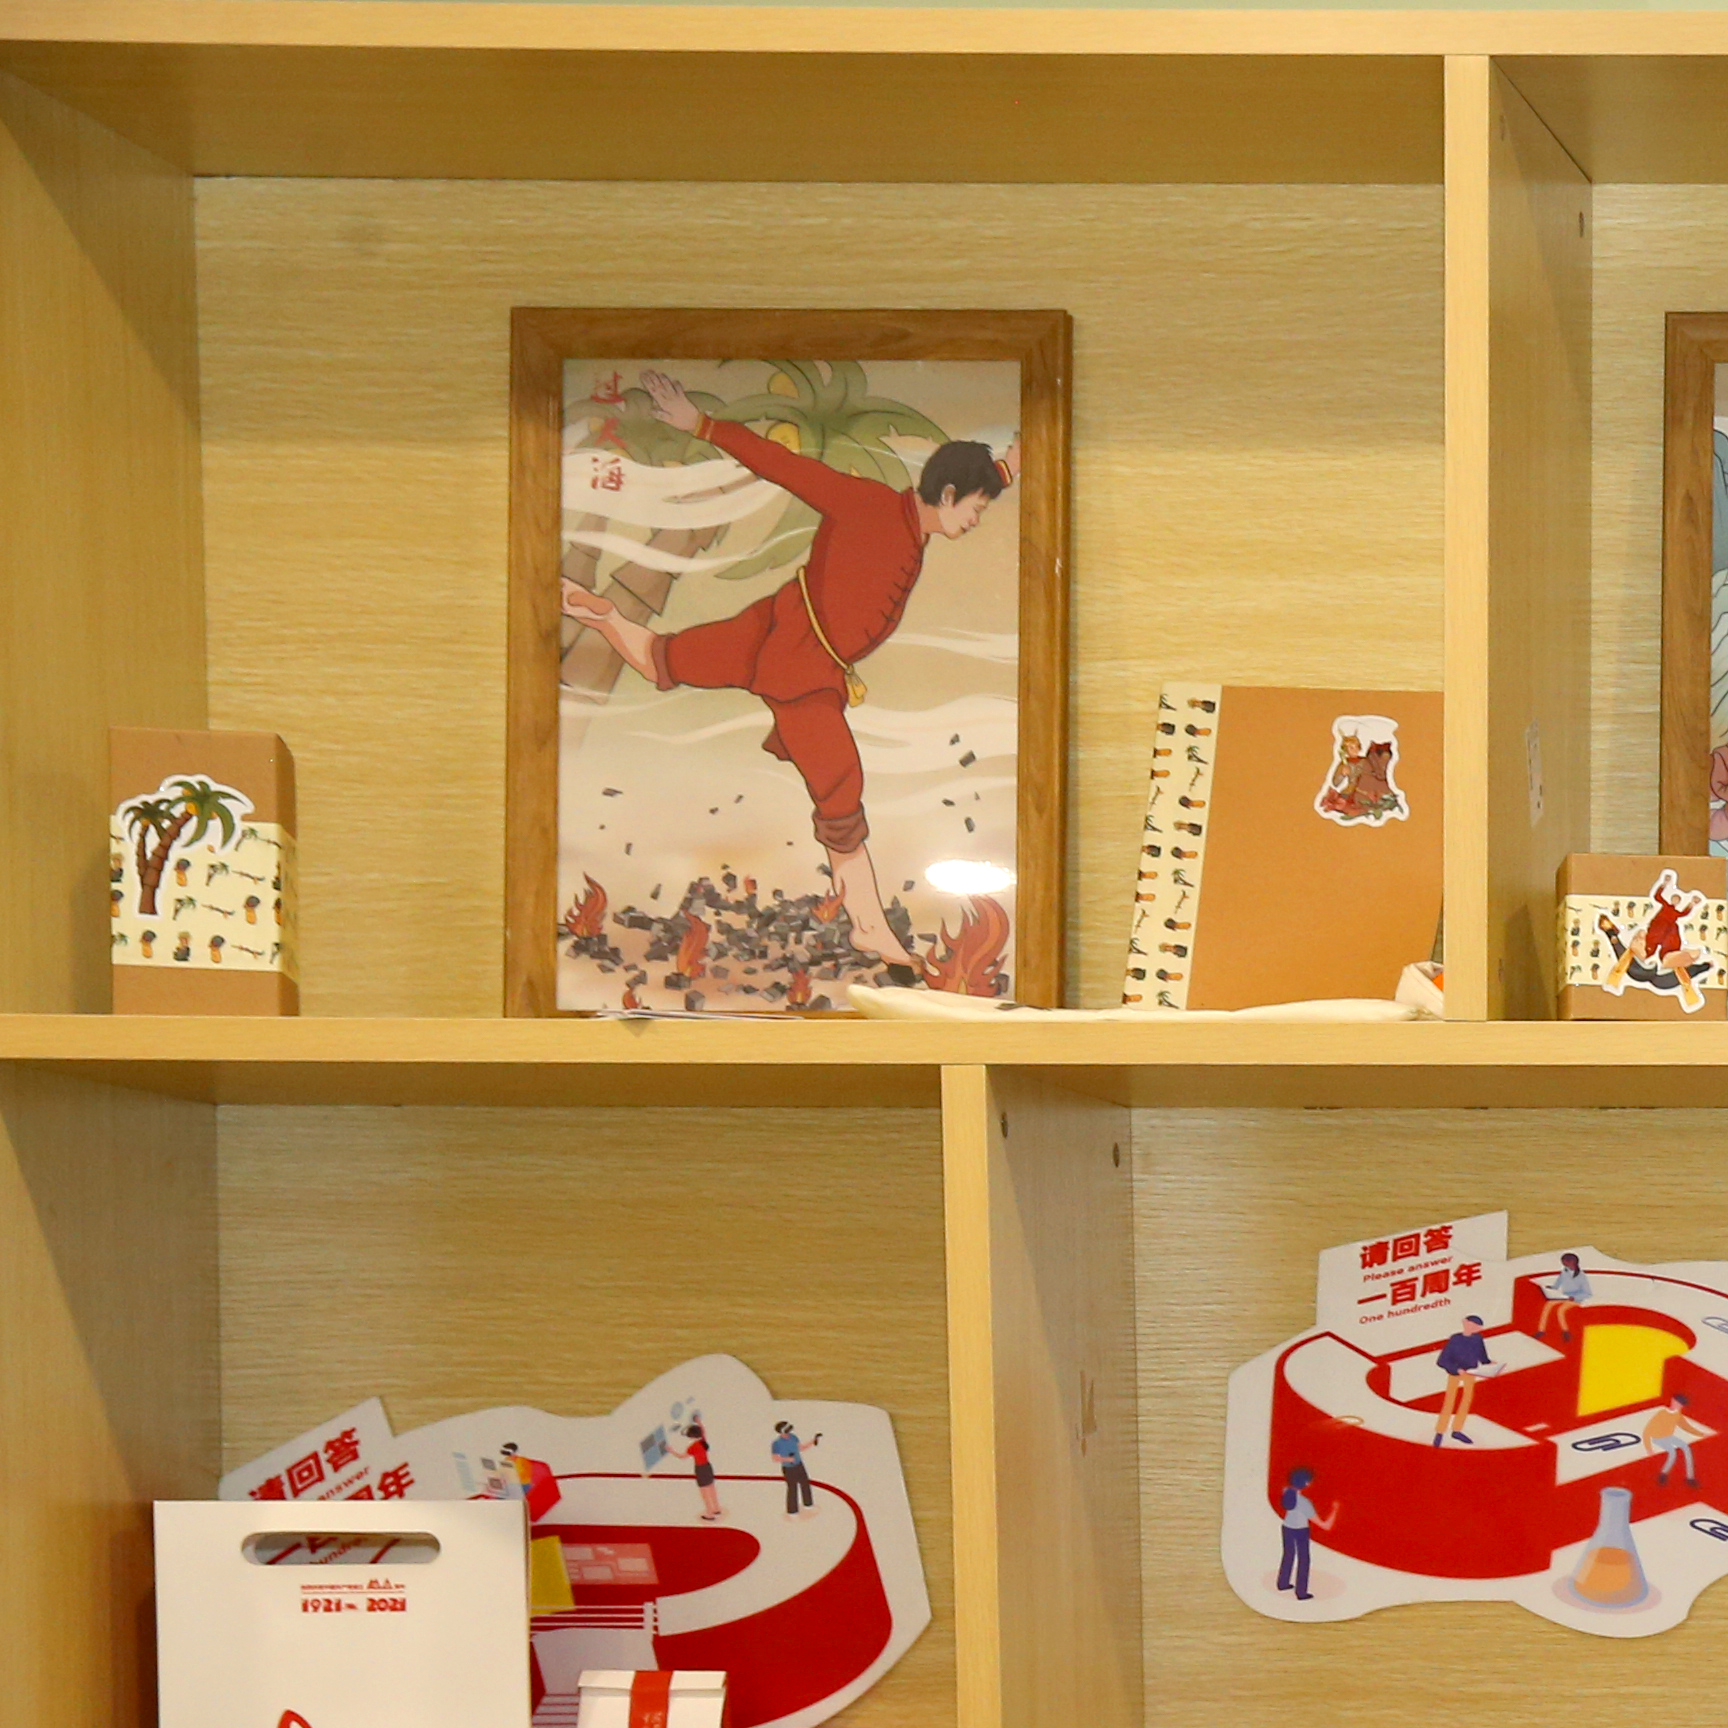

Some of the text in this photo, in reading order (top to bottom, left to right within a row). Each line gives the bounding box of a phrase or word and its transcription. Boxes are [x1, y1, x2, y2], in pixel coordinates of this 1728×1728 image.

[1360, 1225, 1453, 1270] 请回答
[1357, 1262, 1482, 1306] 一百周年
[1363, 1256, 1453, 1283] Please answer
[1359, 1297, 1451, 1325] One hundredth
